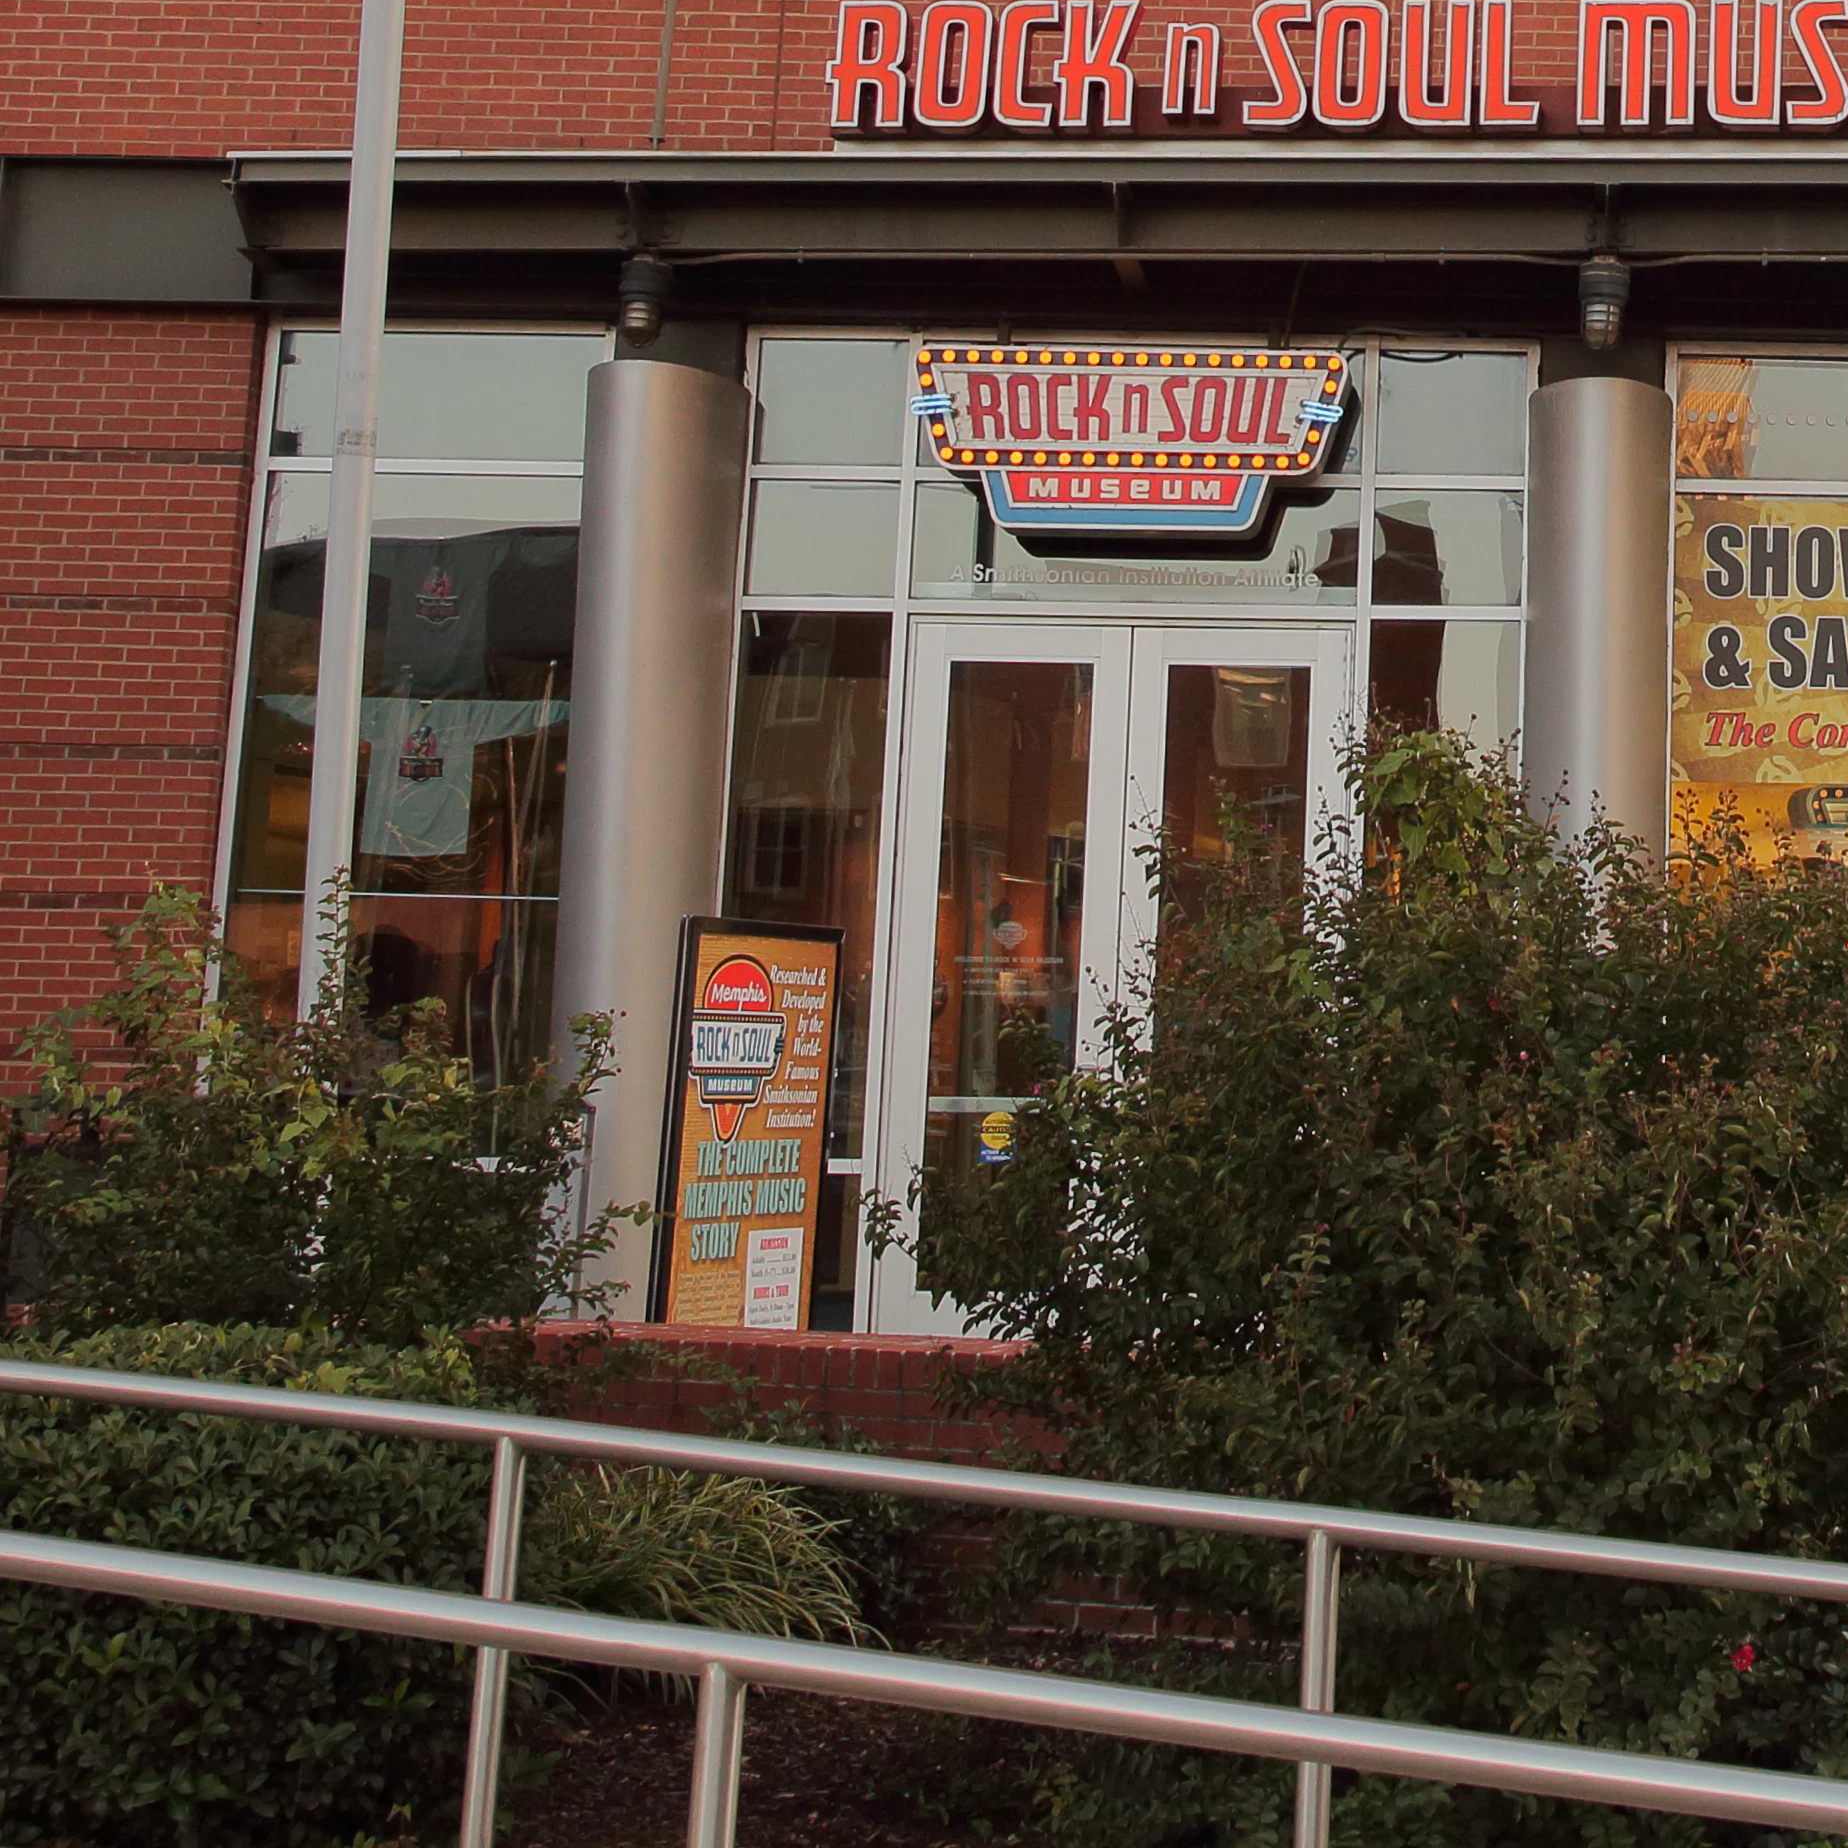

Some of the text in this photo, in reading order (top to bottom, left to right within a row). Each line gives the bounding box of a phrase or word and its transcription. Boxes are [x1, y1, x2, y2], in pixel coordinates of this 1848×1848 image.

[1161, 20, 1219, 117] n
[966, 372, 1290, 445] ROCK n SOUL
[1027, 477, 1221, 501] MUSEUM
[950, 564, 965, 581] A
[1118, 566, 1226, 585] Institution
[1233, 568, 1319, 587] Affiliate
[1703, 624, 1751, 688] &
[1705, 712, 1776, 747] The
[770, 964, 827, 986] Researched &
[710, 981, 767, 1011] Memphis
[781, 989, 827, 1015] Developed
[797, 1013, 824, 1034] by the
[697, 1026, 773, 1063] ROCK n SOUL
[793, 1037, 822, 1057] World-
[784, 1061, 820, 1080] Famous
[708, 1078, 753, 1092] MUSEUM
[763, 1084, 818, 1104] Smithsonian
[765, 1108, 816, 1129] Institution!
[697, 1139, 802, 1177] THE COMPLETE
[684, 1178, 806, 1219] MEMPHIS MUSIC
[690, 1221, 740, 1261] STORY
